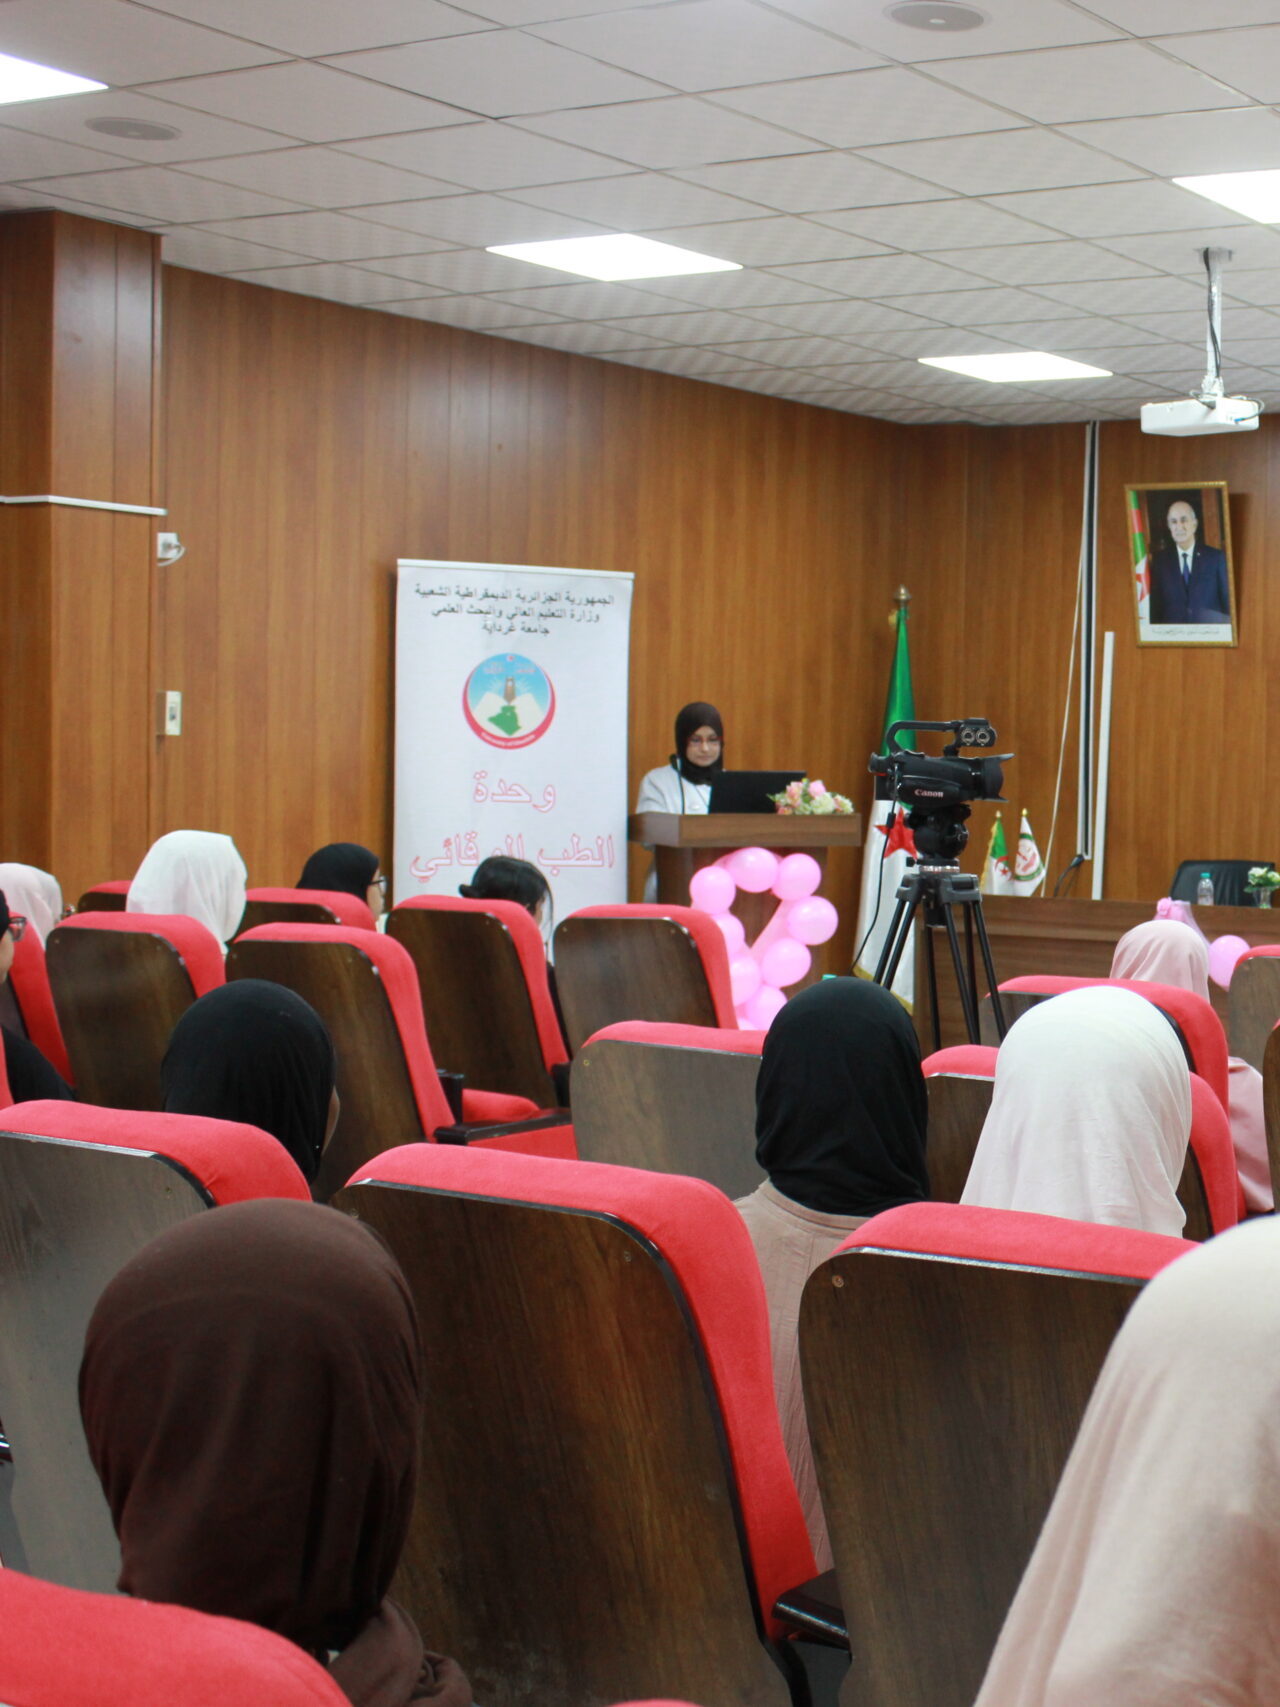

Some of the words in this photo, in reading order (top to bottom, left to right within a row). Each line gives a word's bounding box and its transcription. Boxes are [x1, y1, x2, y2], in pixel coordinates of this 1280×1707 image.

[414, 583, 451, 597] الشعبية
[455, 585, 512, 601] الديمقراطية
[515, 588, 562, 604] الجزائرية
[565, 590, 615, 606] الجمهورية
[431, 603, 463, 618] العلمي
[466, 604, 503, 619] والبحث
[507, 606, 536, 621] العالي
[537, 608, 567, 620] التعليم
[569, 608, 600, 623] وزارة
[481, 621, 517, 636] غرداية
[520, 624, 551, 637] جامعة
[473, 770, 556, 813] وحدة
[914, 788, 944, 798] Canon
[537, 833, 615, 876] الطب
